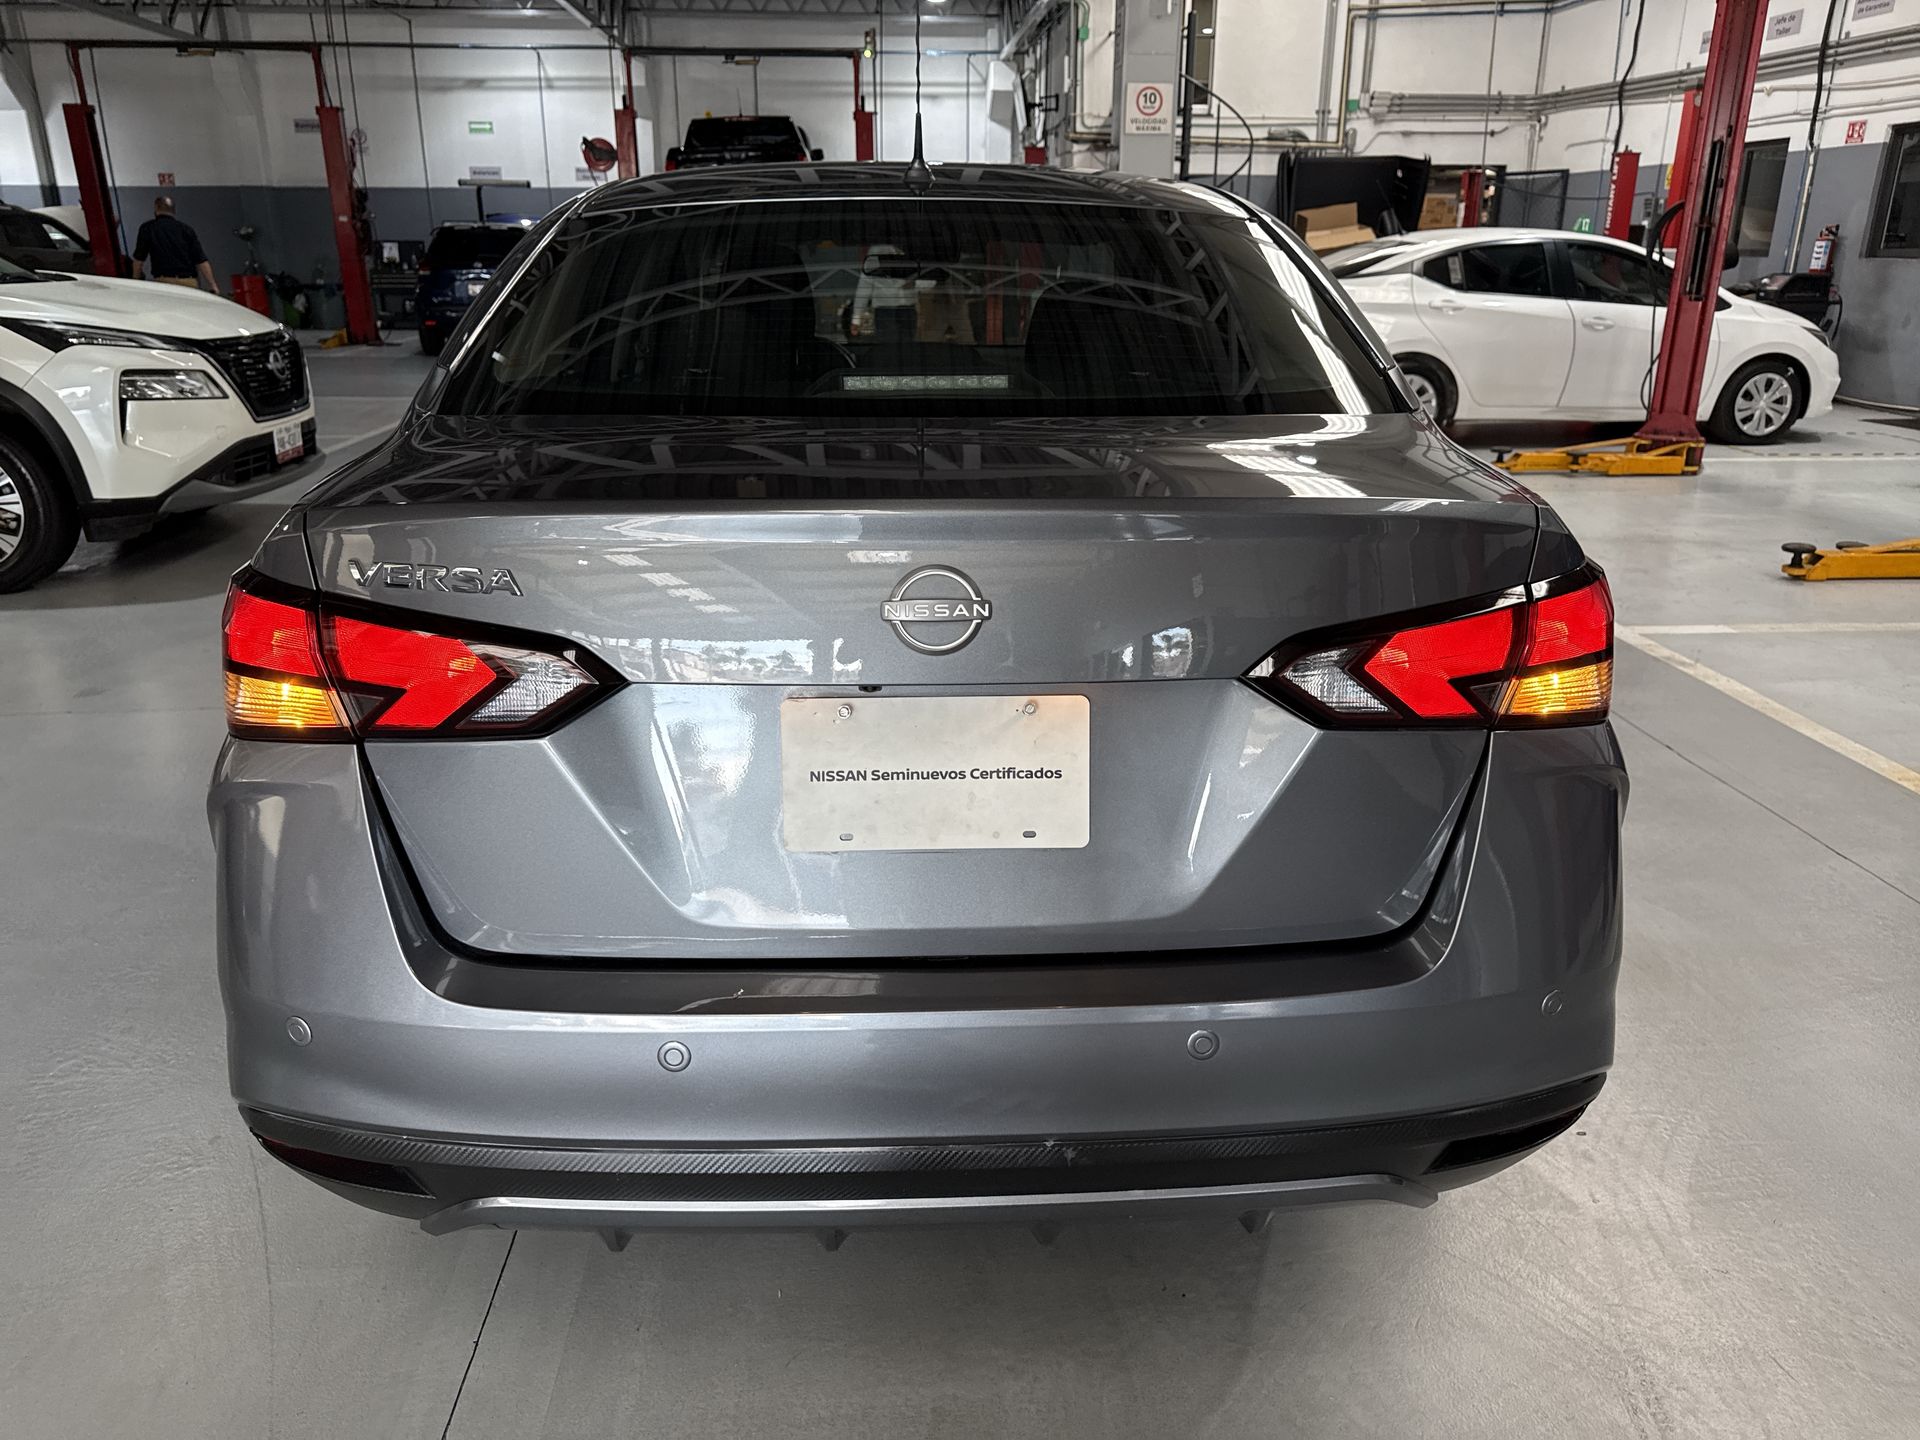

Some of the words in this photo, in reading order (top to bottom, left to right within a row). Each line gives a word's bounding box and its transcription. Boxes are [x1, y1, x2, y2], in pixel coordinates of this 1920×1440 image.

[1774, 16, 1787, 26] Jefe
[1788, 14, 1796, 22] de
[1775, 26, 1791, 36] Taller
[1142, 92, 1157, 105] 10
[348, 559, 524, 597] VERSA
[884, 603, 989, 617] NISSAN
[809, 769, 868, 783] NISSAN
[870, 768, 967, 782] Seminuevos
[969, 767, 1063, 780] Certificados
